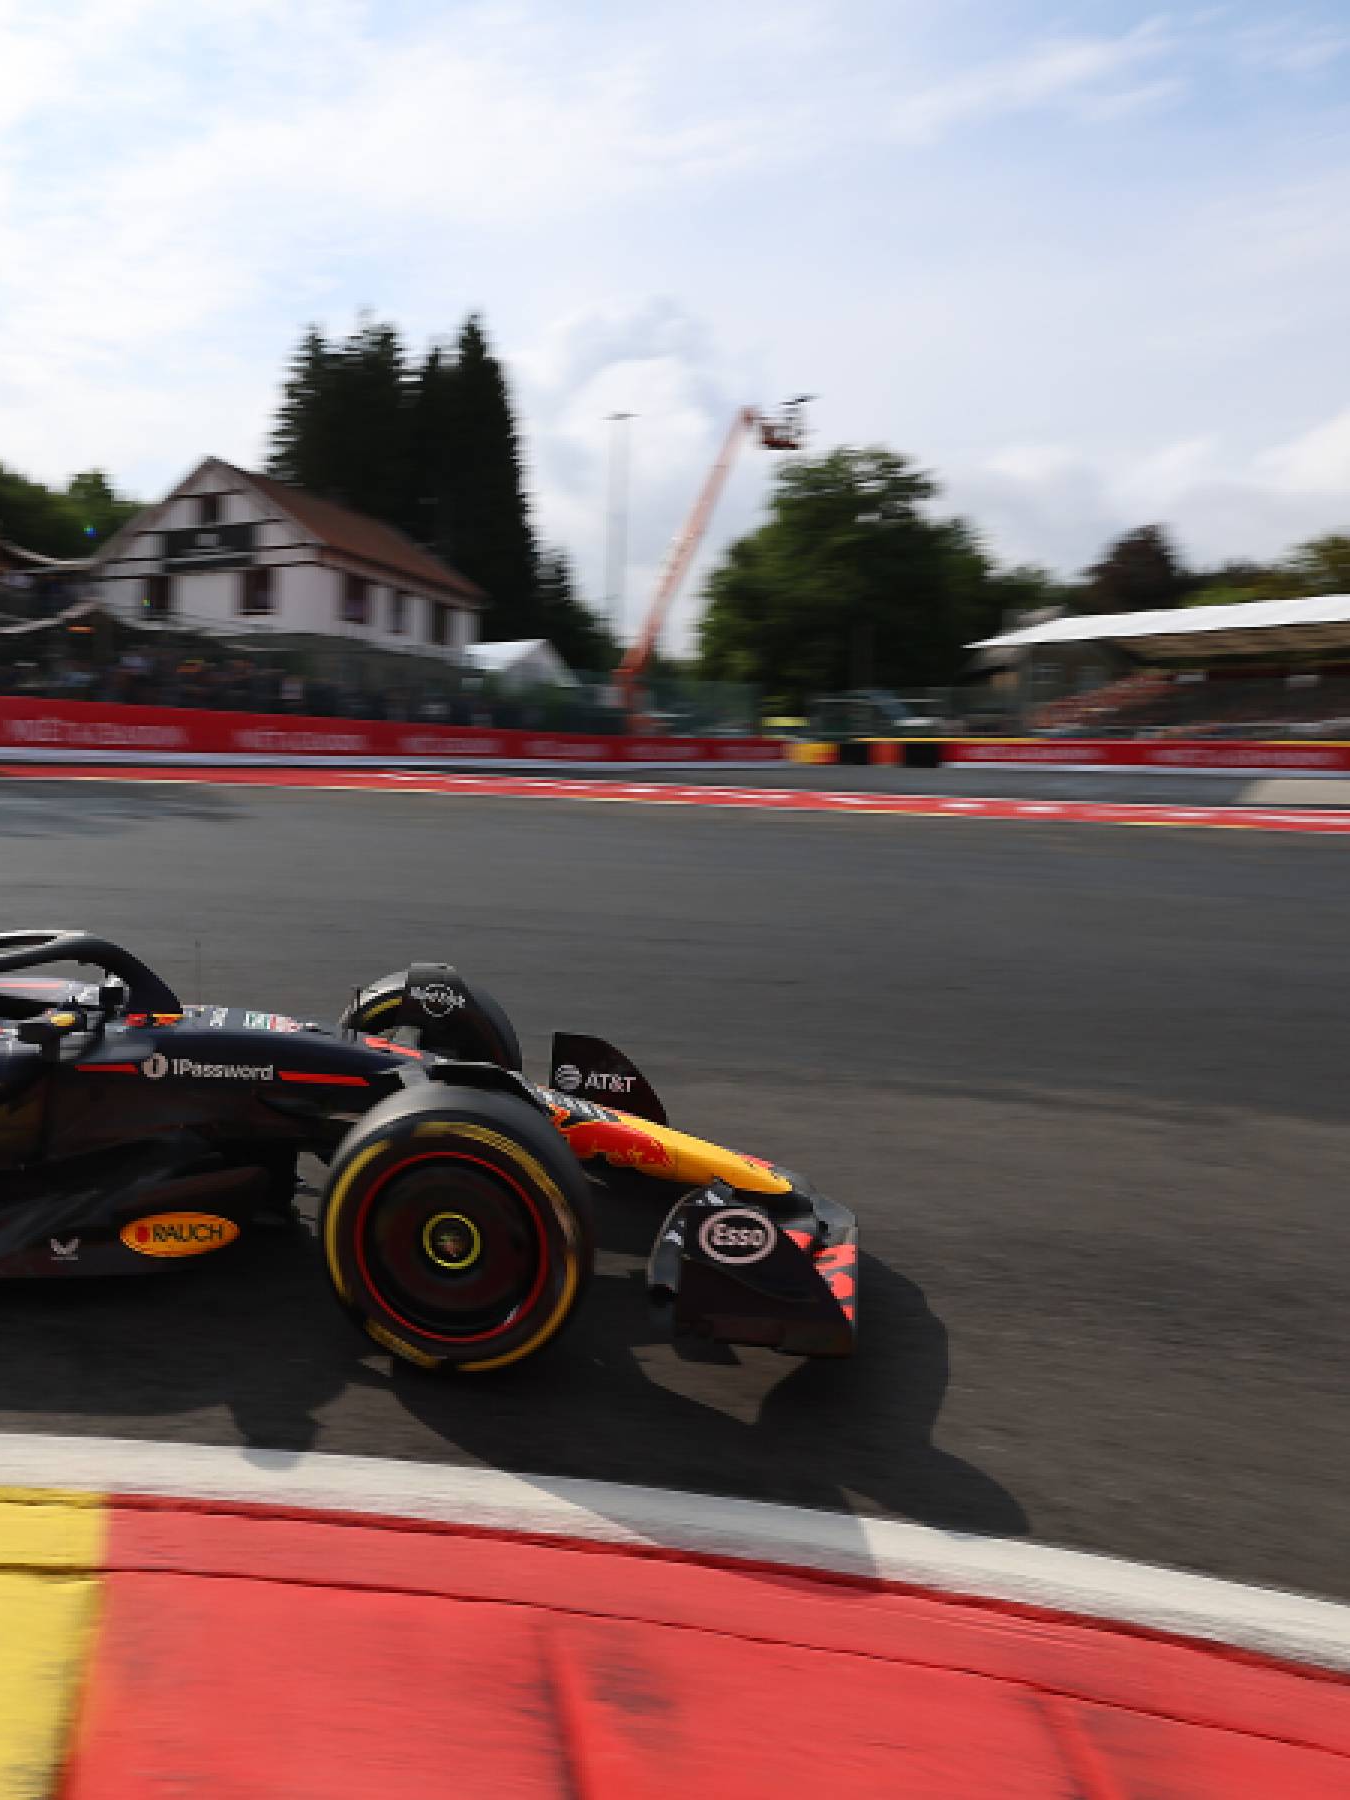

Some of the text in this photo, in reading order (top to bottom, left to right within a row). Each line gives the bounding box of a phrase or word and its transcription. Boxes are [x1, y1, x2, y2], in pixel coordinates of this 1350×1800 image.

[172, 1060, 274, 1082] 1Password
[585, 1072, 636, 1093] AT&T
[152, 1222, 224, 1244] RAUCH
[711, 1223, 763, 1247] Esso
